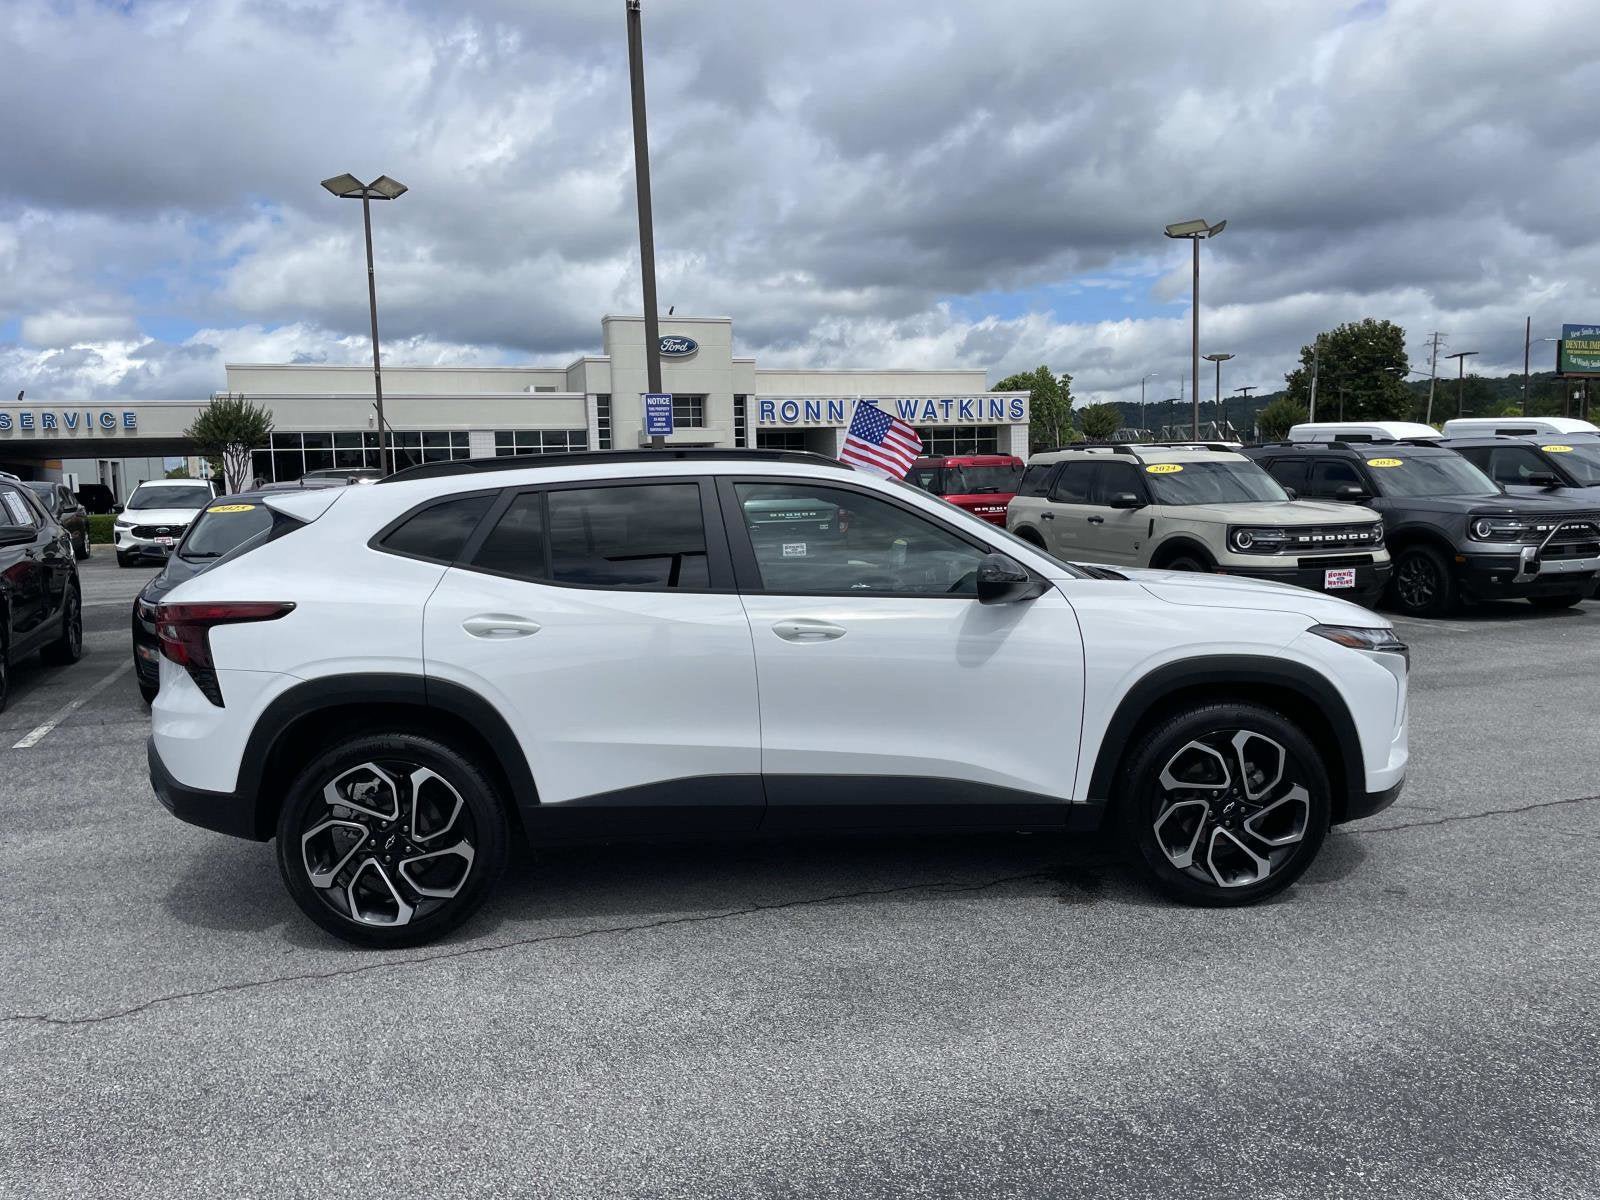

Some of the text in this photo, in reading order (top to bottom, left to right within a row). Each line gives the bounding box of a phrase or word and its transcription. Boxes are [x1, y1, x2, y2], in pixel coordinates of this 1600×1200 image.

[660, 338, 689, 351] Ford
[1565, 339, 1588, 349] DENTAL
[647, 397, 670, 405] NOTICE
[759, 398, 1025, 422] RONN WATKINS
[0, 411, 138, 430] SERVICE
[1299, 533, 1369, 541] BRONCO
[1327, 571, 1353, 579] RONNIE
